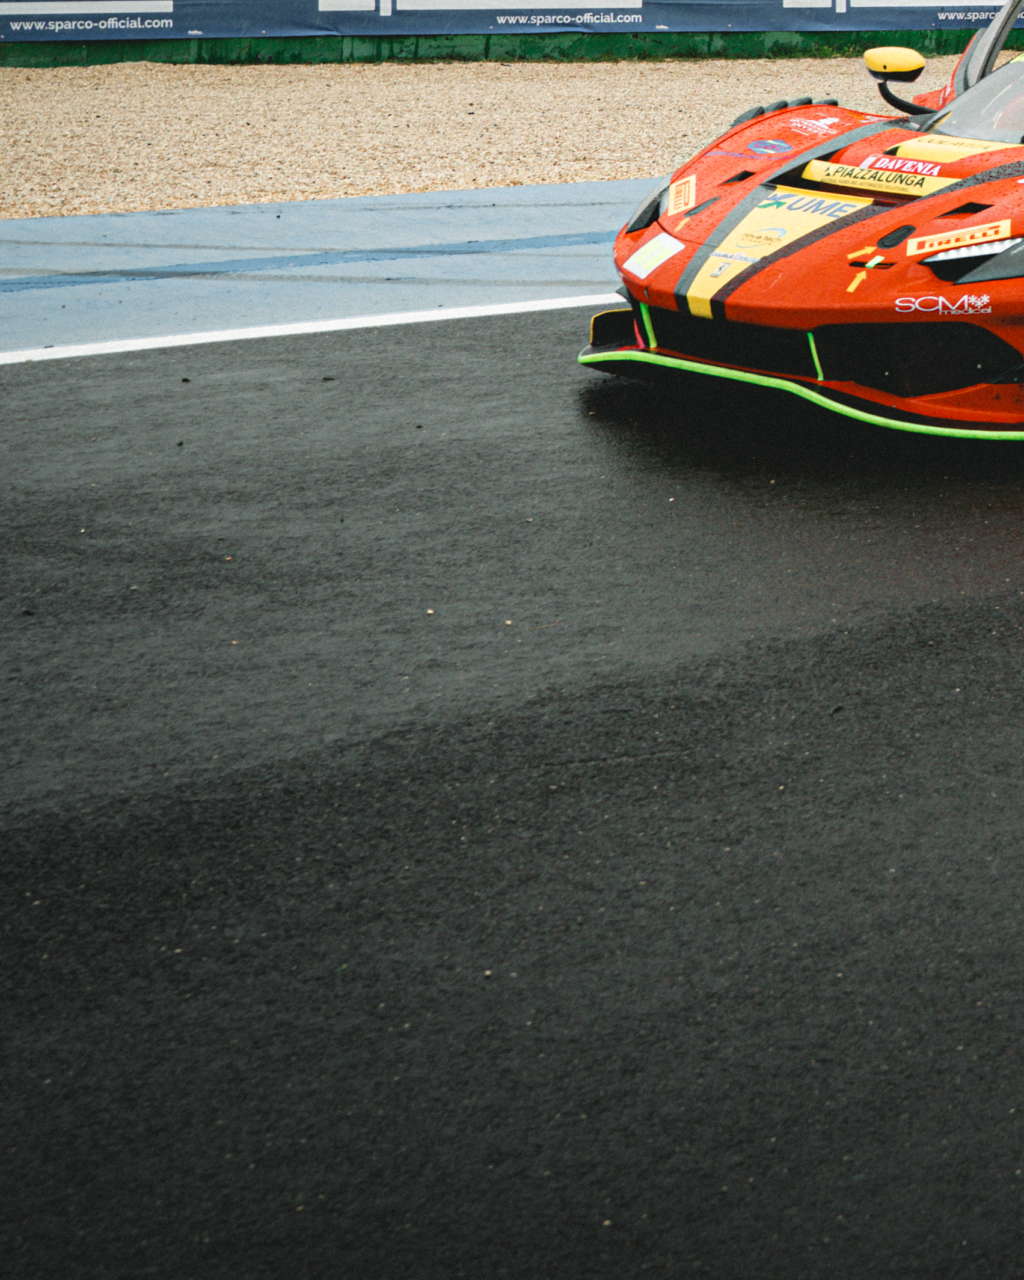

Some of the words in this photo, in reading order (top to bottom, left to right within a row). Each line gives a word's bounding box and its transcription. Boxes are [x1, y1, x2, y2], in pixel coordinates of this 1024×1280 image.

[10, 17, 174, 32] www.sparco-official.com
[496, 12, 643, 26] www.sparco-official.com
[873, 157, 942, 176] DAVENIA
[833, 166, 926, 188] PIAZZALUNGA
[786, 197, 857, 219] UME
[894, 295, 969, 313] SCM
[939, 306, 992, 316] medical
